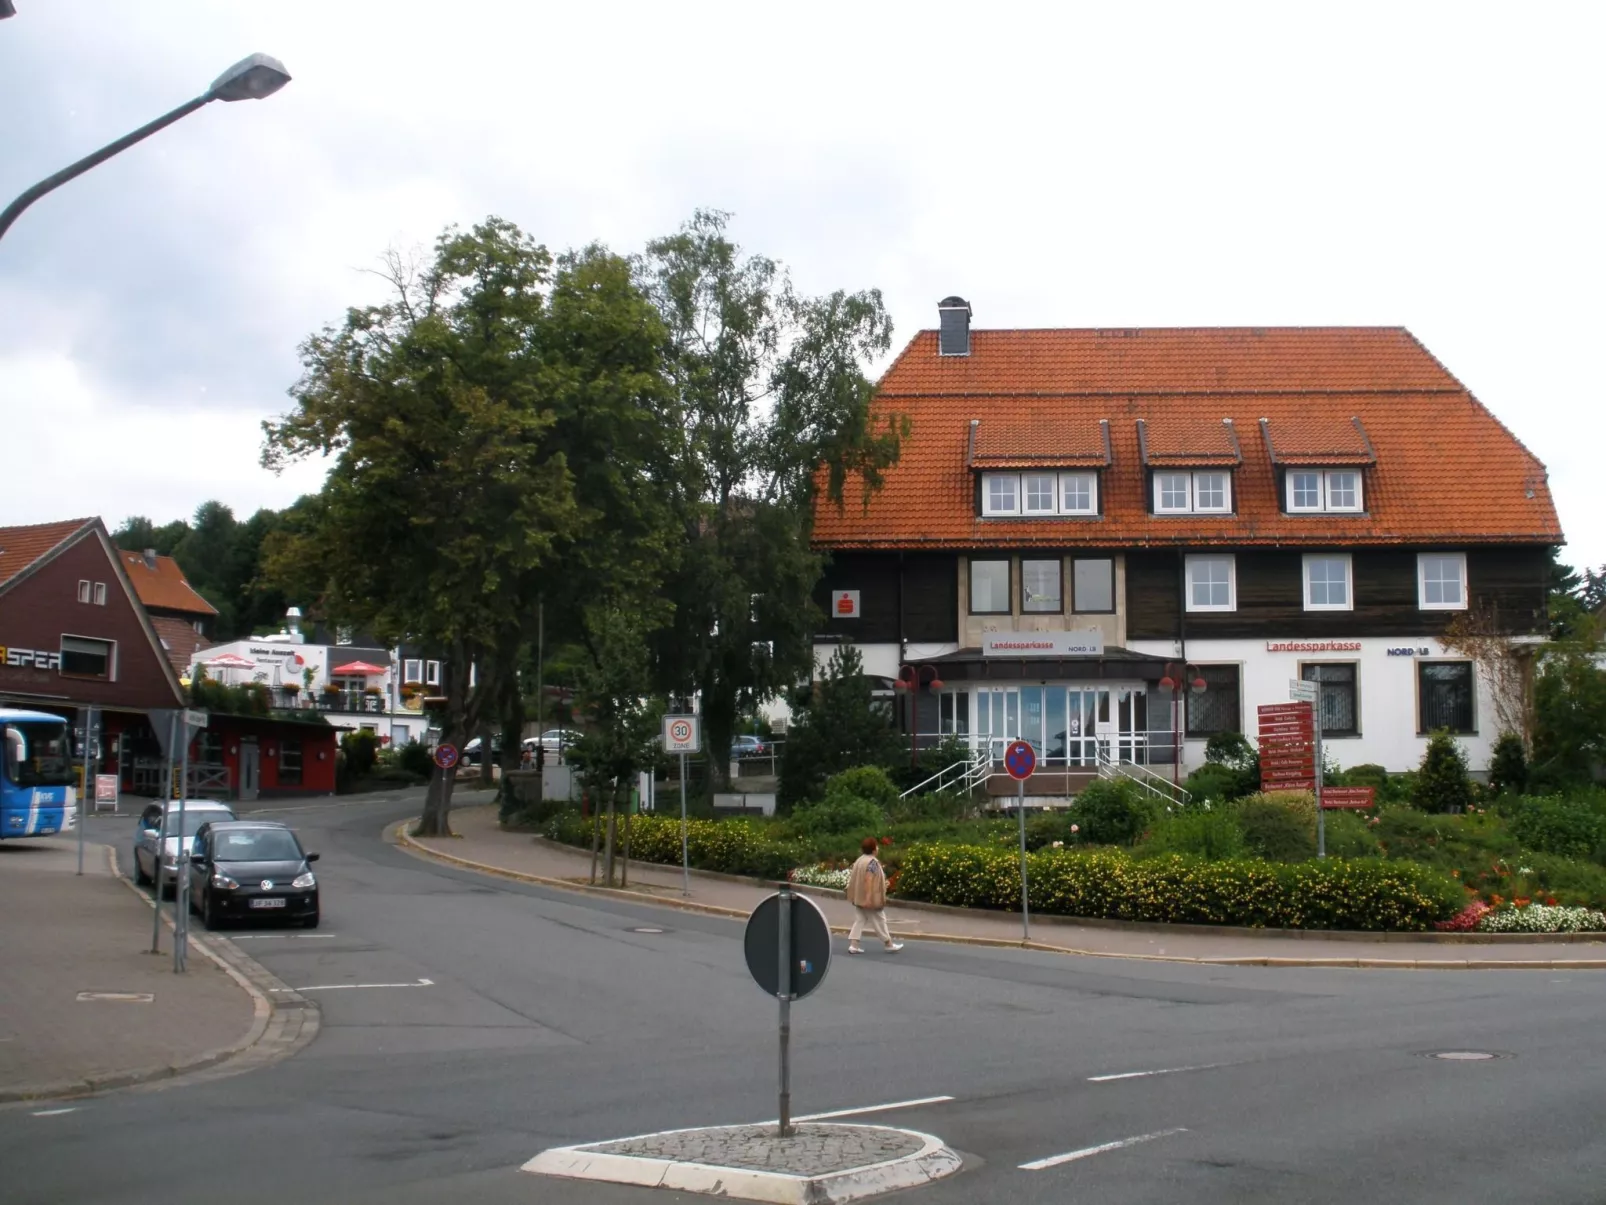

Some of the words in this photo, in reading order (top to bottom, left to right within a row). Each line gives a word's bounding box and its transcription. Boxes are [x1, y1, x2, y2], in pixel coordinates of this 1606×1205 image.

[990, 640, 1054, 650] Landessparkasse
[1266, 640, 1361, 654] Landessparkasse
[1387, 648, 1414, 656] NORD
[675, 726, 687, 736] 30
